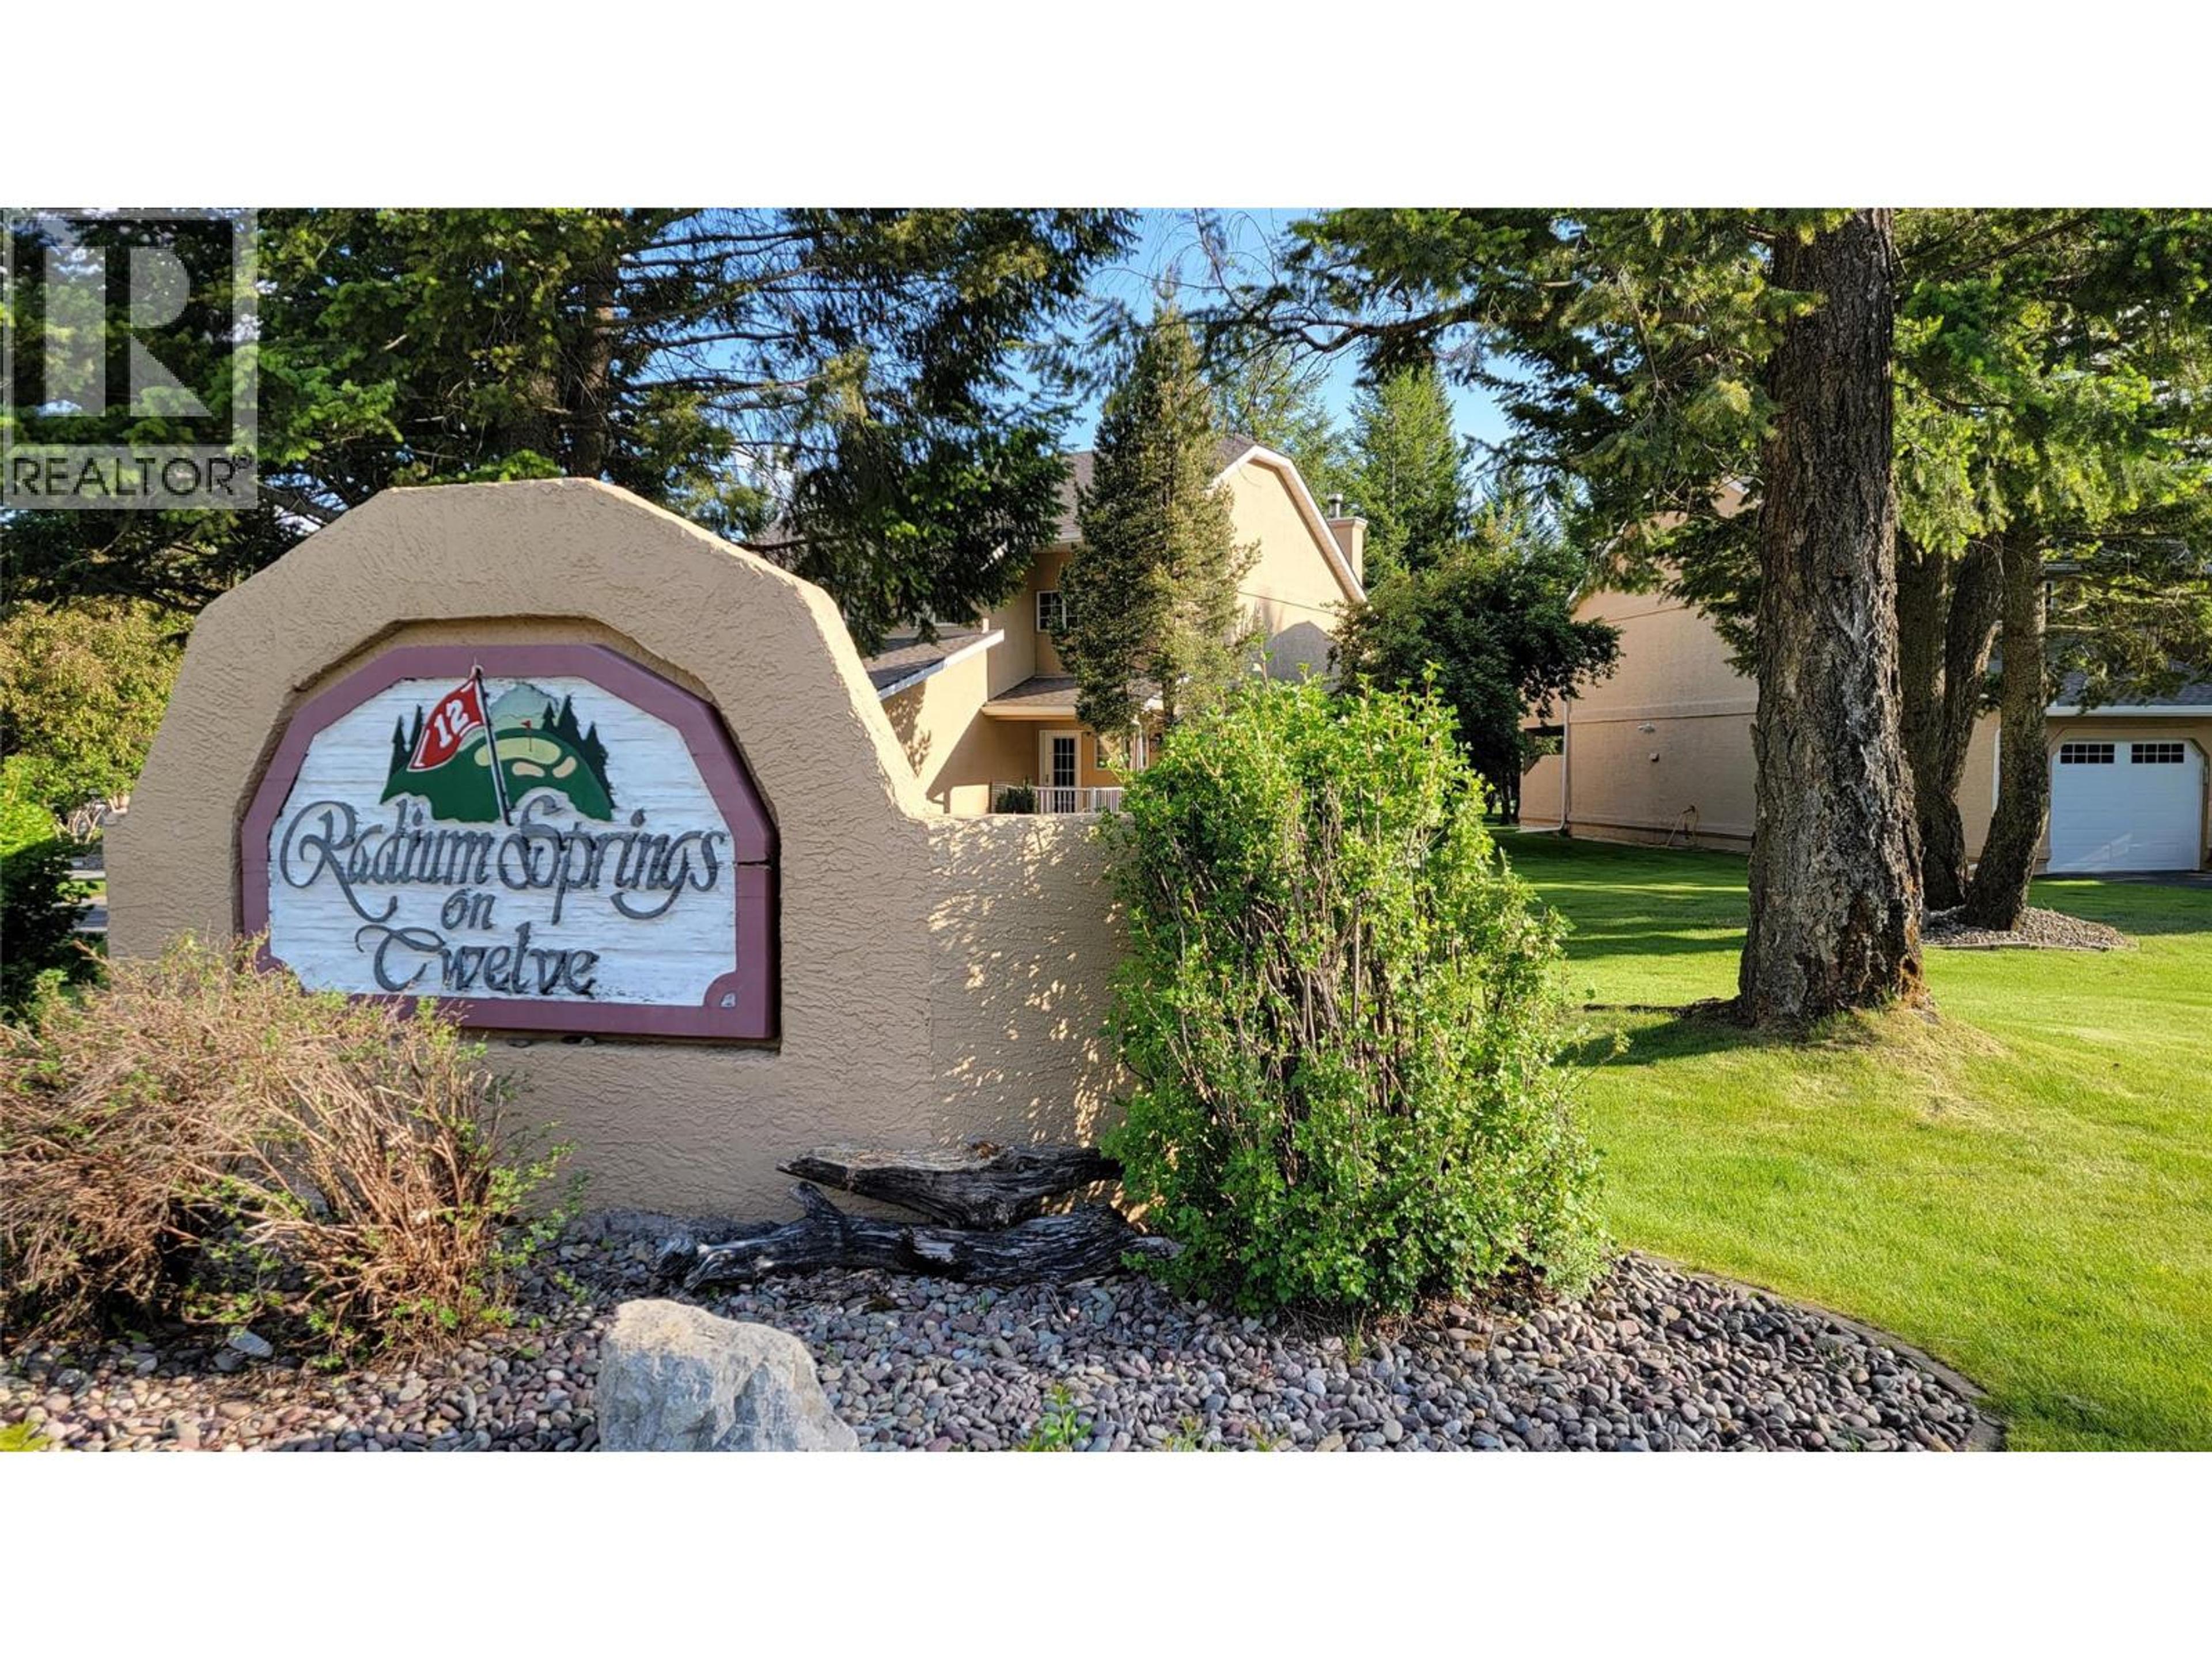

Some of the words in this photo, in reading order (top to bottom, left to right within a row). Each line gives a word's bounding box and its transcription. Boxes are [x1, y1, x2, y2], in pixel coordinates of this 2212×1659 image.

[434, 698, 469, 749] 12
[279, 798, 495, 922] Radium
[497, 795, 730, 925] Springs
[441, 887, 495, 930] on
[355, 923, 600, 997] Twelve
